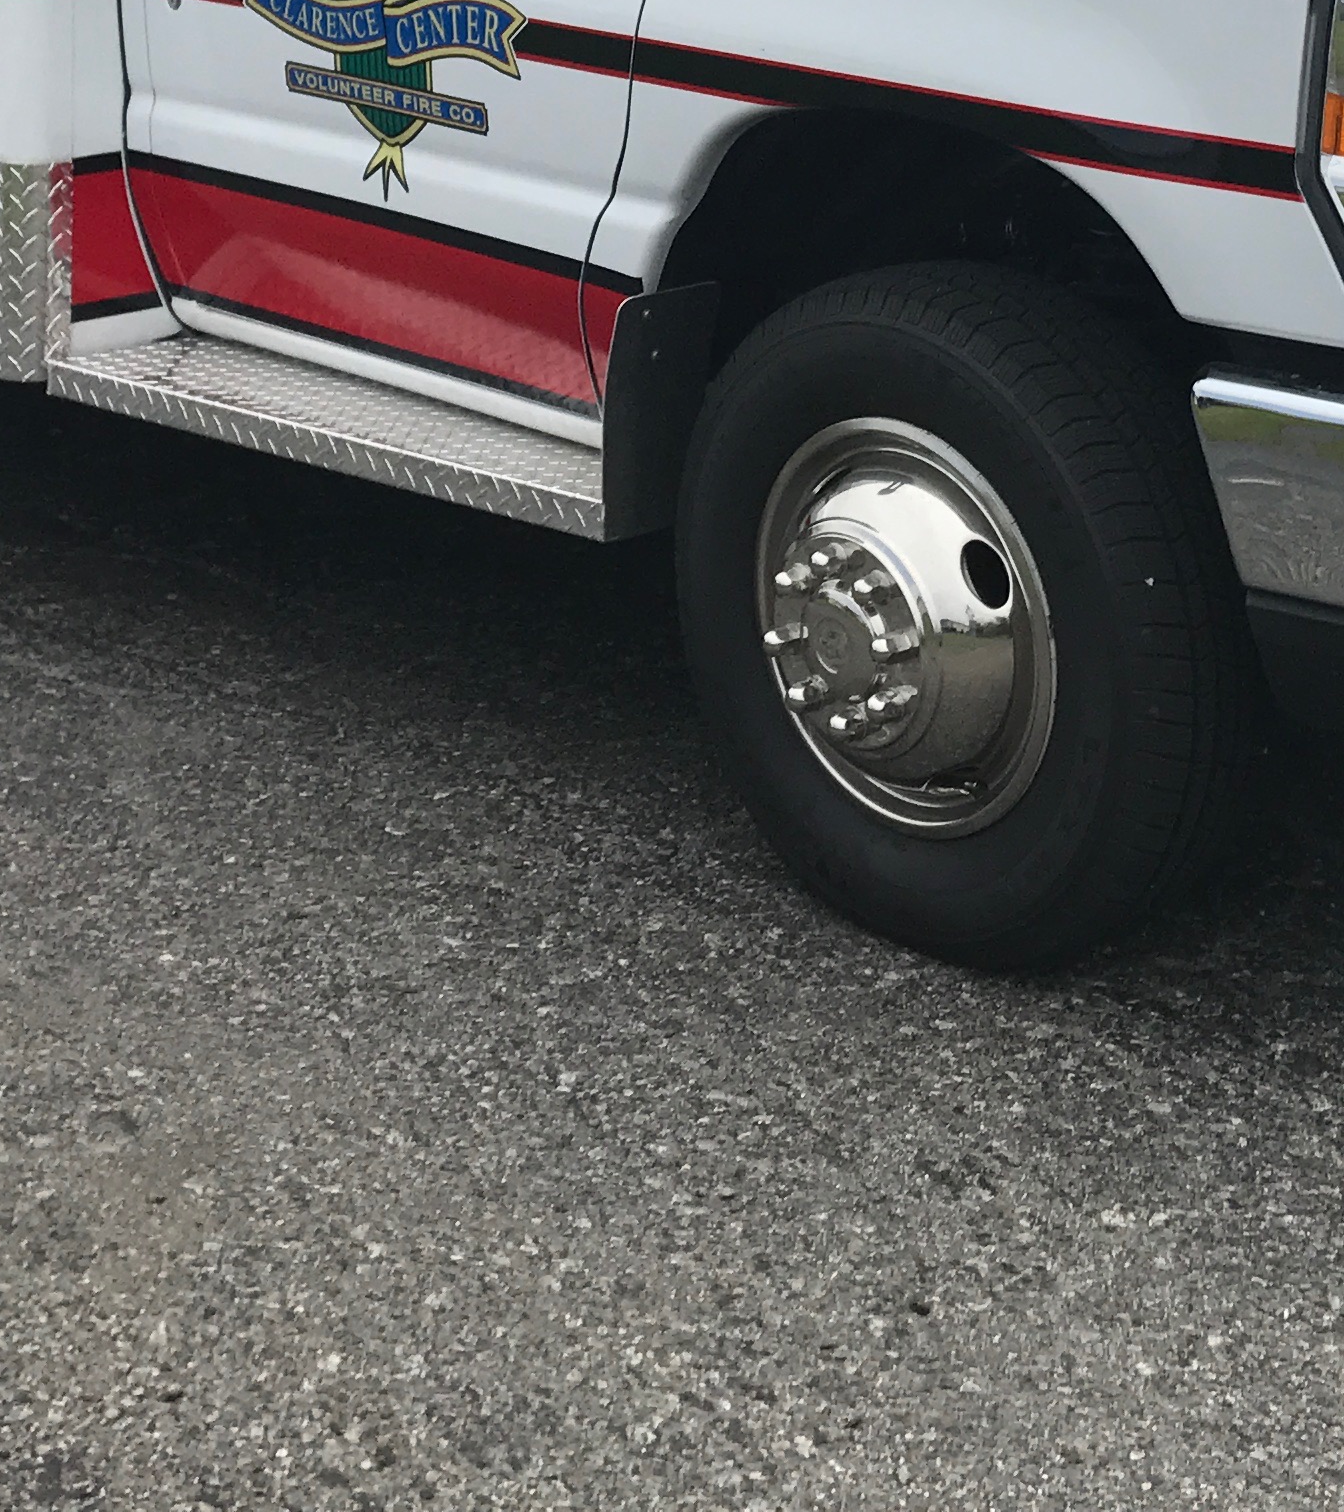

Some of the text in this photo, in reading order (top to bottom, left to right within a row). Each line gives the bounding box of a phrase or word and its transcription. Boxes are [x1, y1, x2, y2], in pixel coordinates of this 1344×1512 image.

[396, 5, 500, 53] CENTER
[294, 71, 481, 125] VOLUNTEER FIRE CO.
